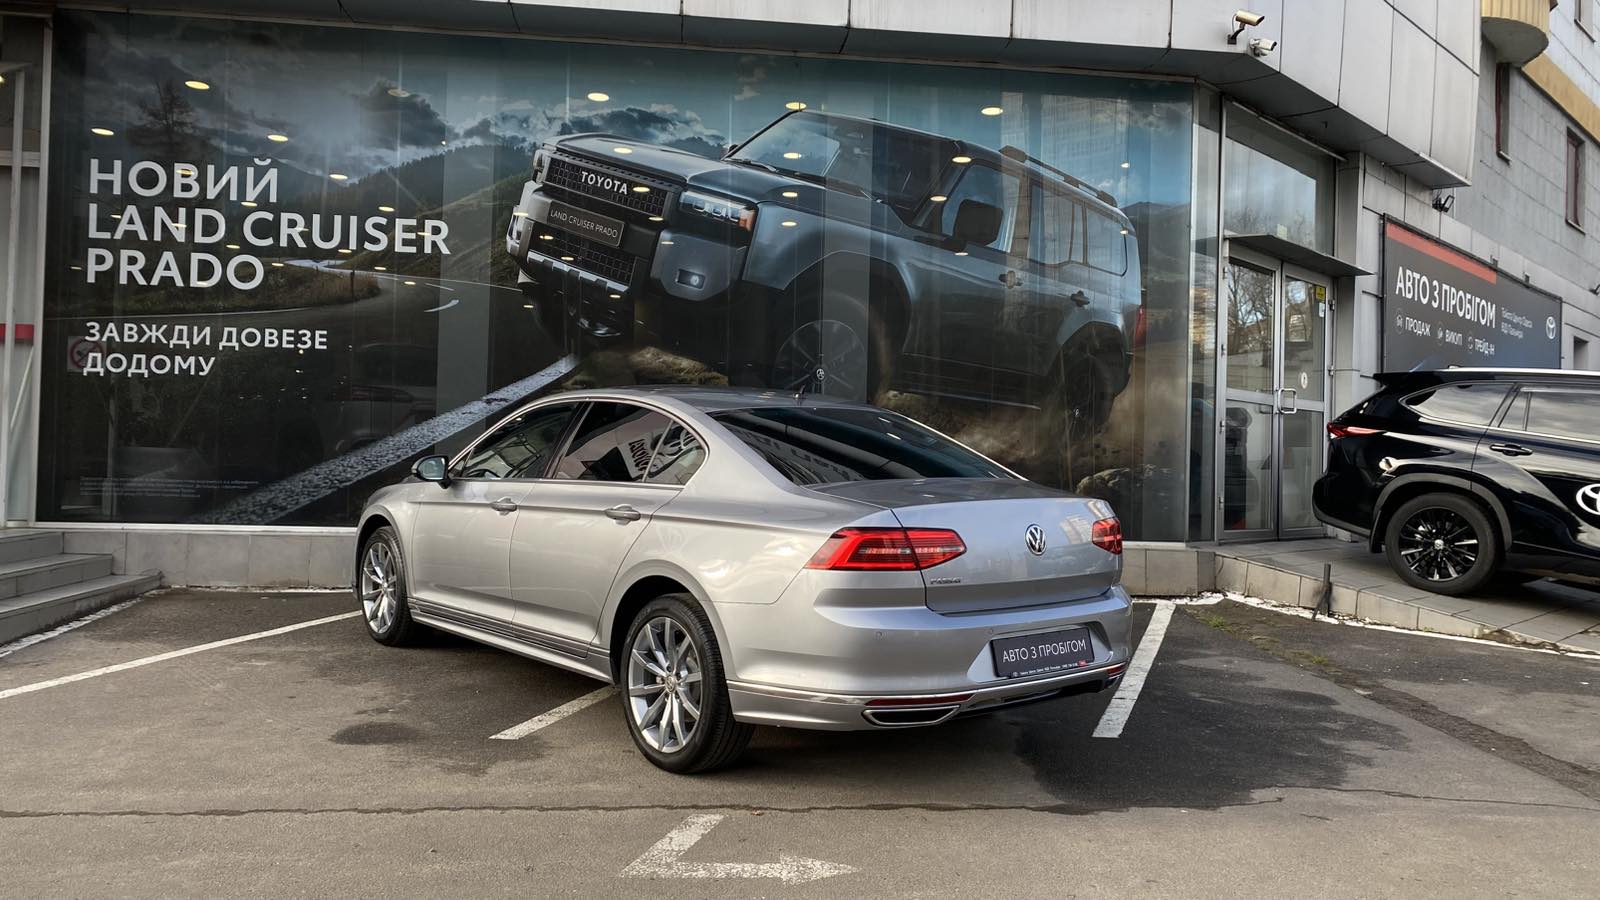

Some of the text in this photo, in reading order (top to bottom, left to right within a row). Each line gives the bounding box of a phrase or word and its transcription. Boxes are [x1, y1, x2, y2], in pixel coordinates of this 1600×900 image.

[90, 158, 277, 202] НОВИЙ
[581, 171, 628, 195] TOYOTA
[88, 203, 451, 255] LAND CRUISER
[550, 209, 619, 238] LAND CRUISER PRADO
[87, 248, 265, 290] PRADO
[1395, 266, 1430, 304] АВТО
[1441, 283, 1496, 328] ПРОБІГОМ
[85, 322, 328, 350] ЗАВЖДИ ДОВЕЗЕ
[1405, 317, 1431, 336] ПРОДАЖ
[83, 353, 215, 378] ДОДОМУ
[1003, 647, 1029, 663] АВТО
[1038, 639, 1087, 657] ПРОБІГОМ
